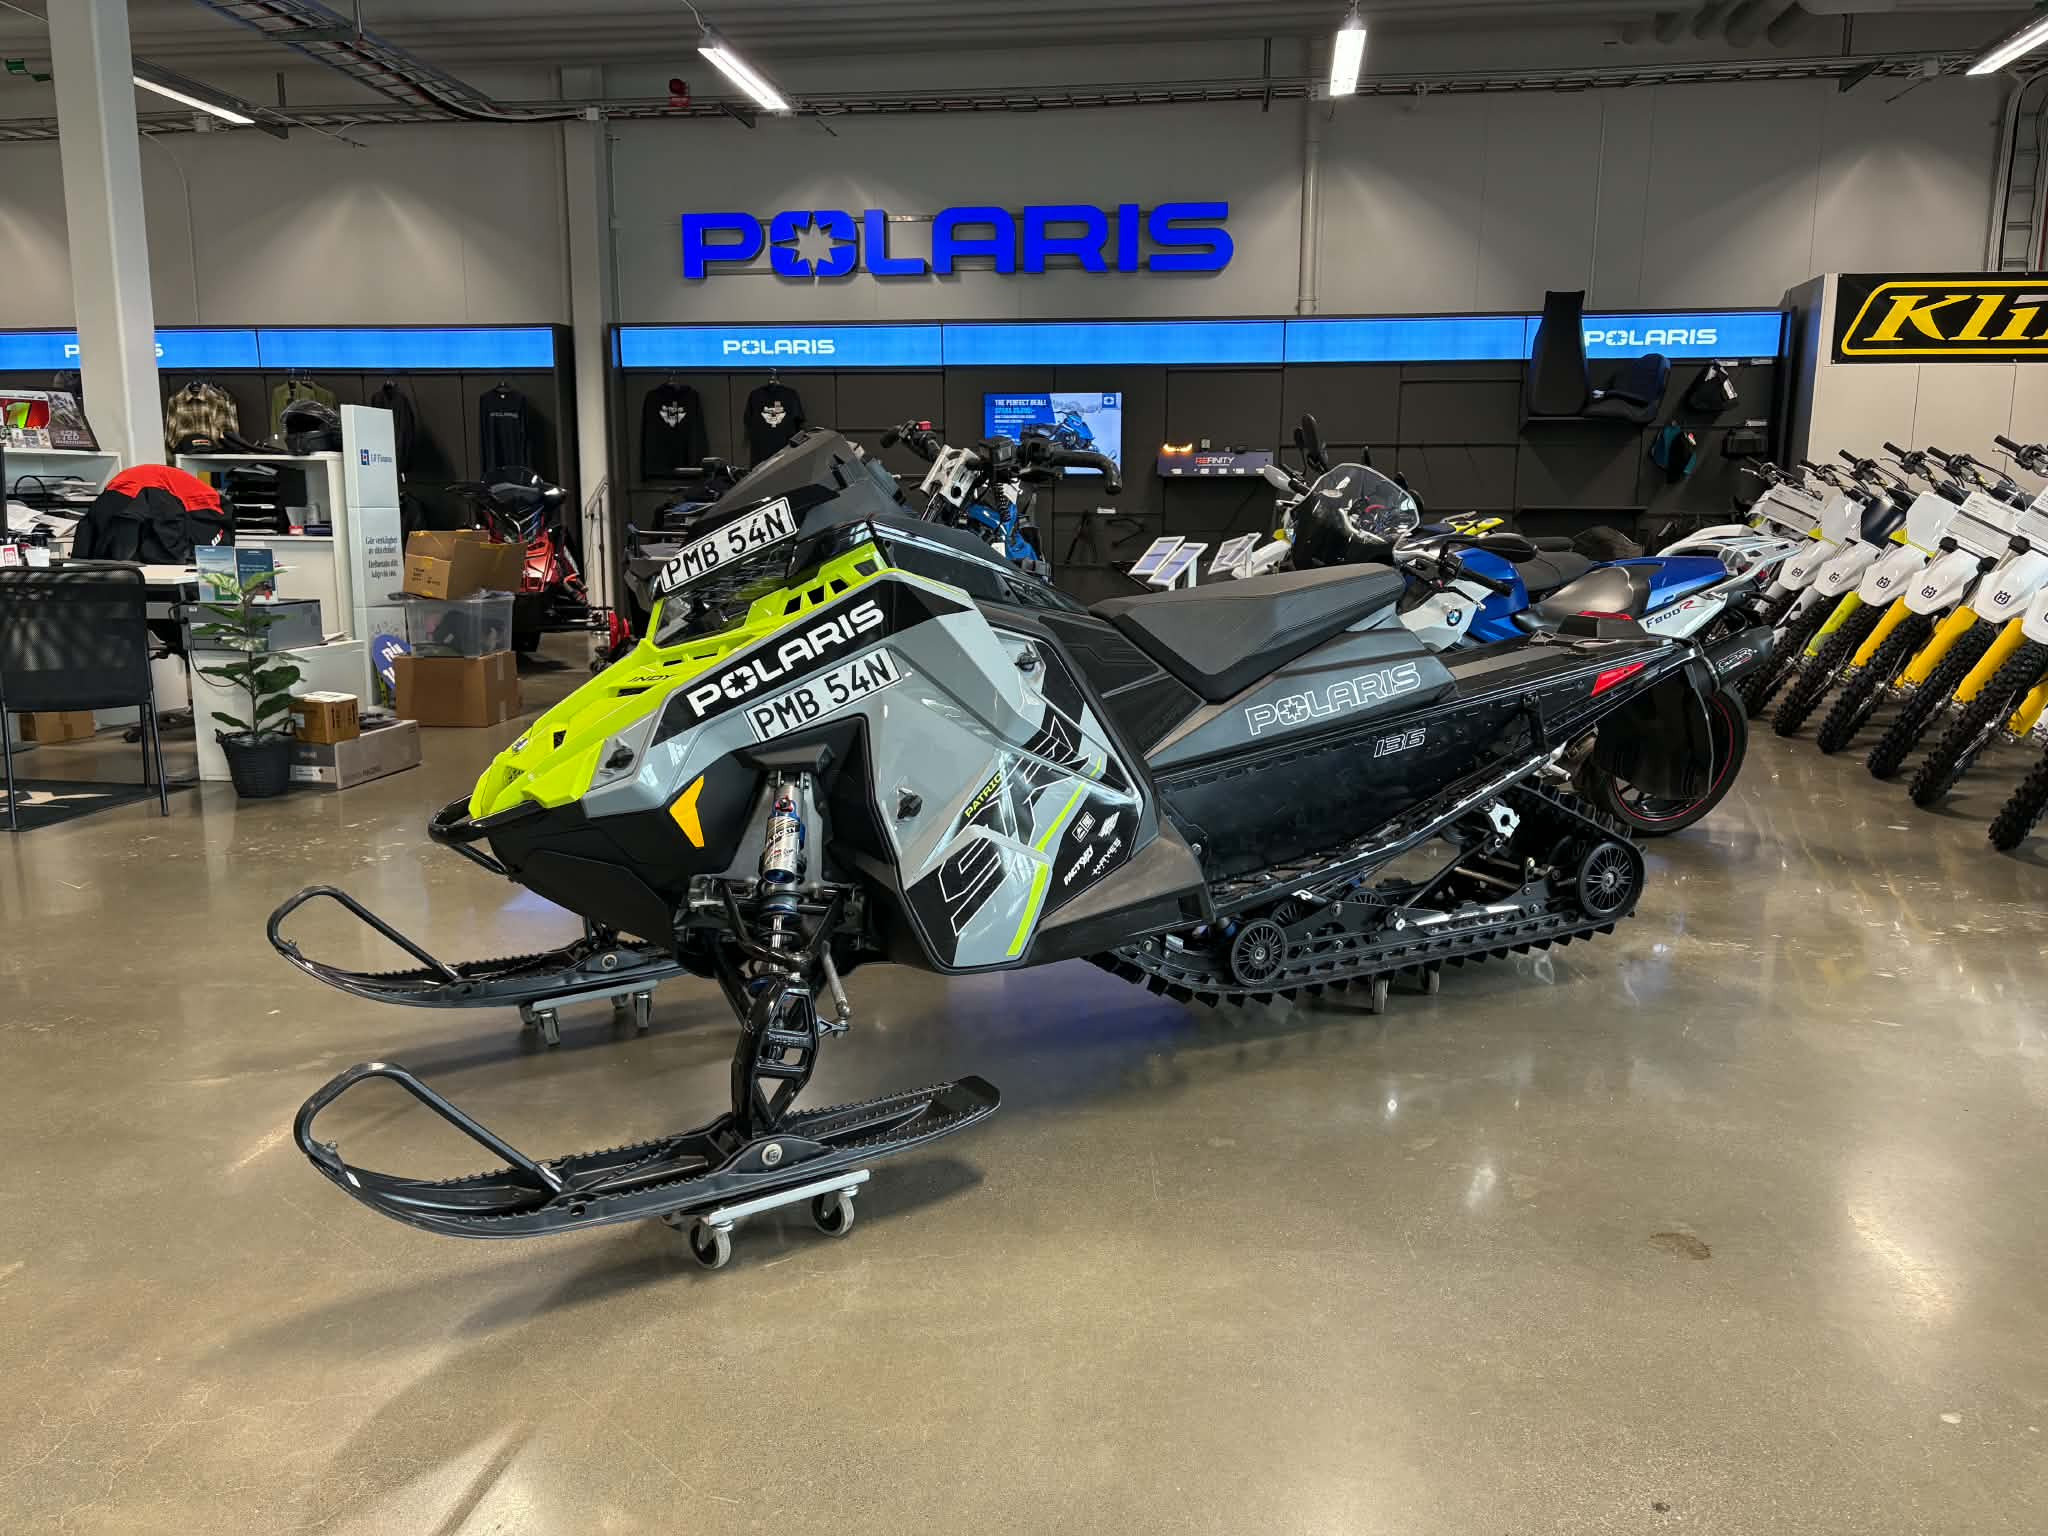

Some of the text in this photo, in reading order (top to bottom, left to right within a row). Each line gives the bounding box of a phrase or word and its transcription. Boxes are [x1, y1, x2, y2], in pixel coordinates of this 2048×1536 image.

[682, 201, 1234, 278] POLARIS
[723, 339, 836, 355] POLARIS
[1585, 329, 1718, 346] POLARIS
[665, 508, 787, 585] PMB 54N
[686, 599, 885, 717] POLARIS
[753, 653, 893, 739] PMB 54N
[1245, 662, 1421, 736] POLARIS
[1373, 728, 1427, 758] 136
